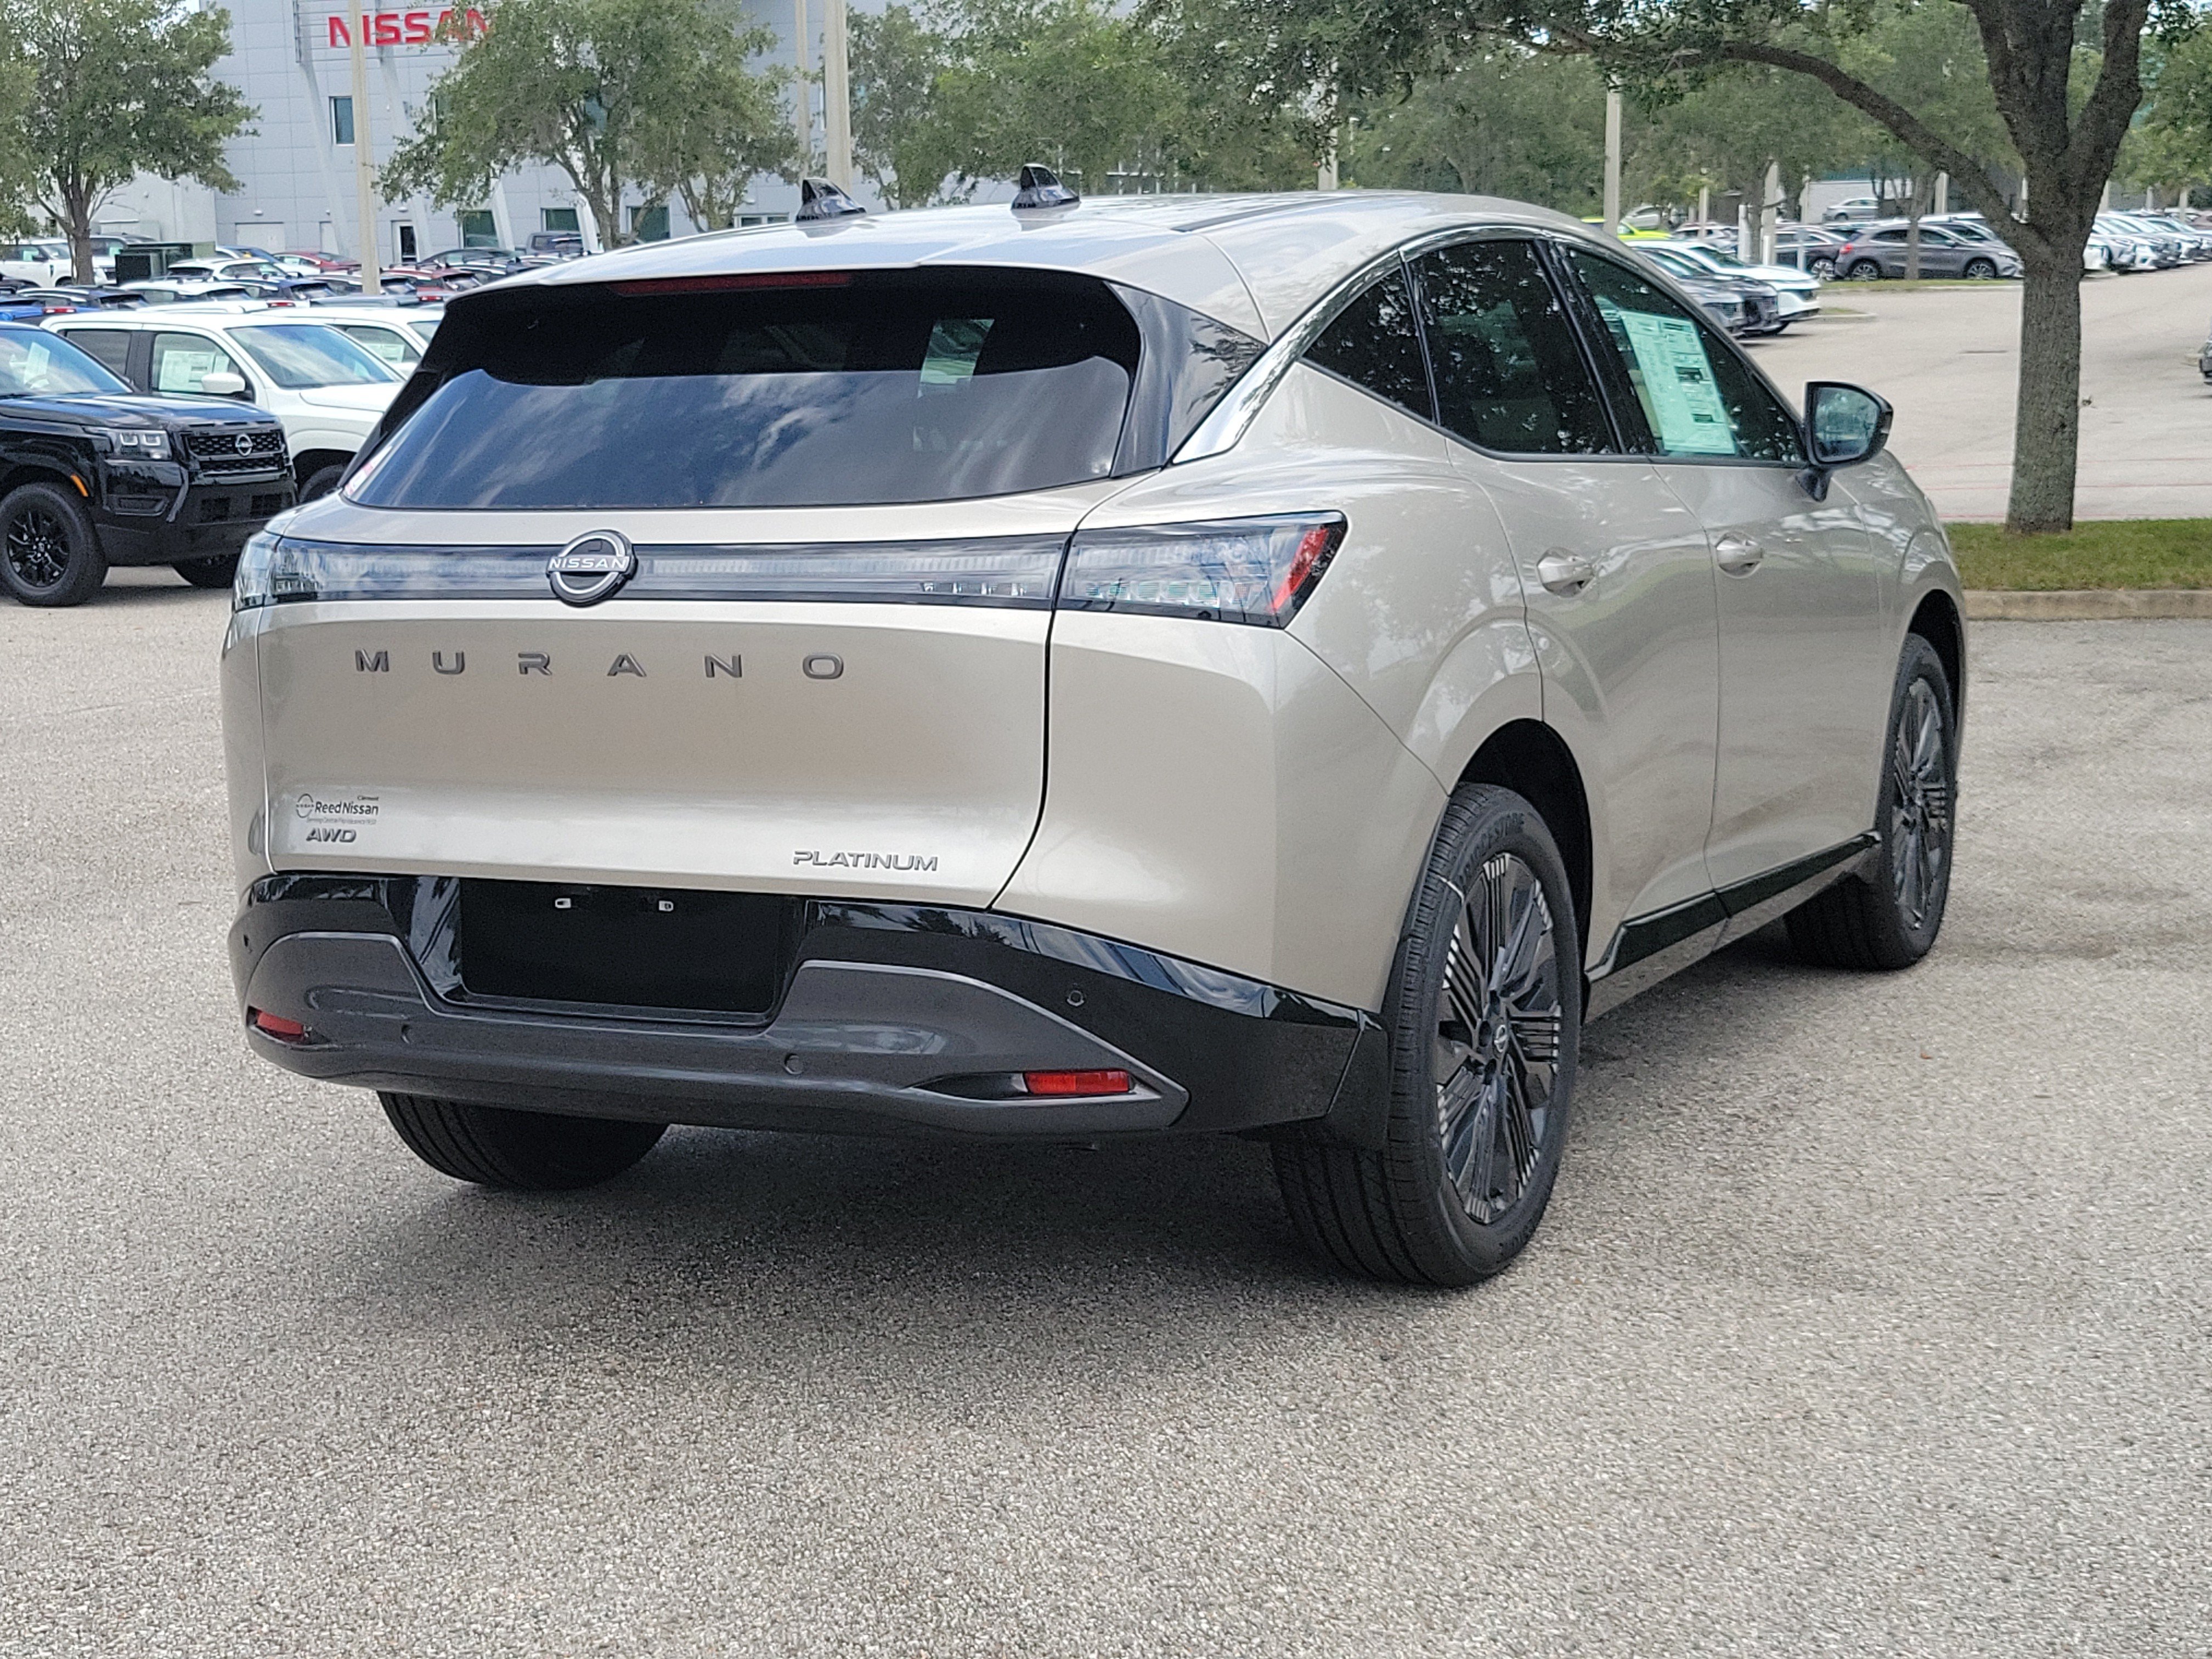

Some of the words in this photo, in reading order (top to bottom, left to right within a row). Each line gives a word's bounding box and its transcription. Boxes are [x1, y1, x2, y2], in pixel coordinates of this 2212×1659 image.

[549, 558, 627, 569] NISSAN
[354, 648, 845, 680] MURANO
[306, 828, 357, 843] AWD
[793, 851, 938, 872] PLATINUM
